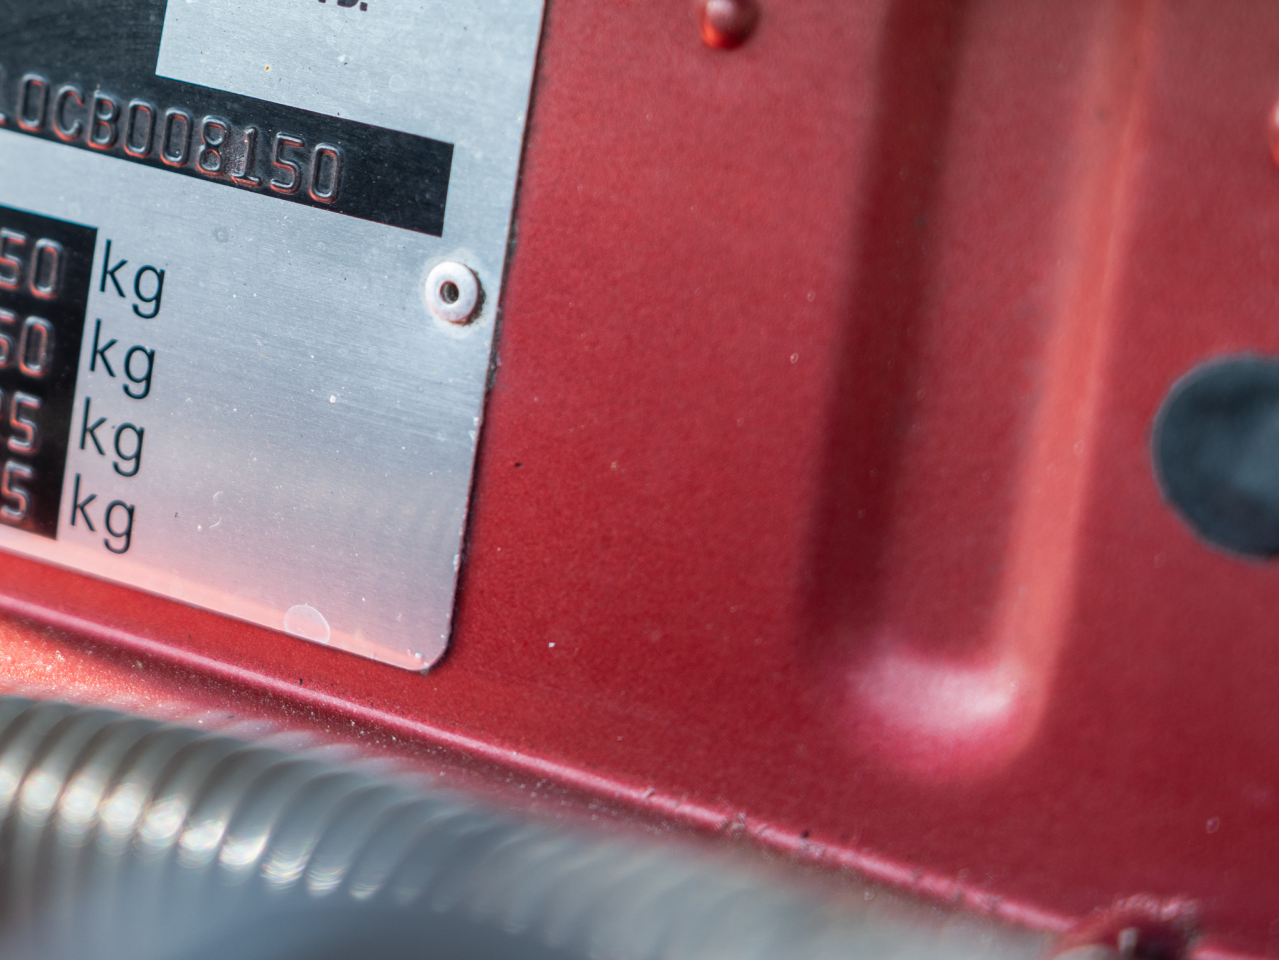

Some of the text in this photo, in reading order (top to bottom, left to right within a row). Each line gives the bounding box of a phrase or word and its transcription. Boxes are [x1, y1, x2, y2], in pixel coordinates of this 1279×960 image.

[99, 239, 165, 319] kg
[89, 318, 155, 399] kg
[80, 396, 144, 477] kg
[70, 472, 135, 554] kg
